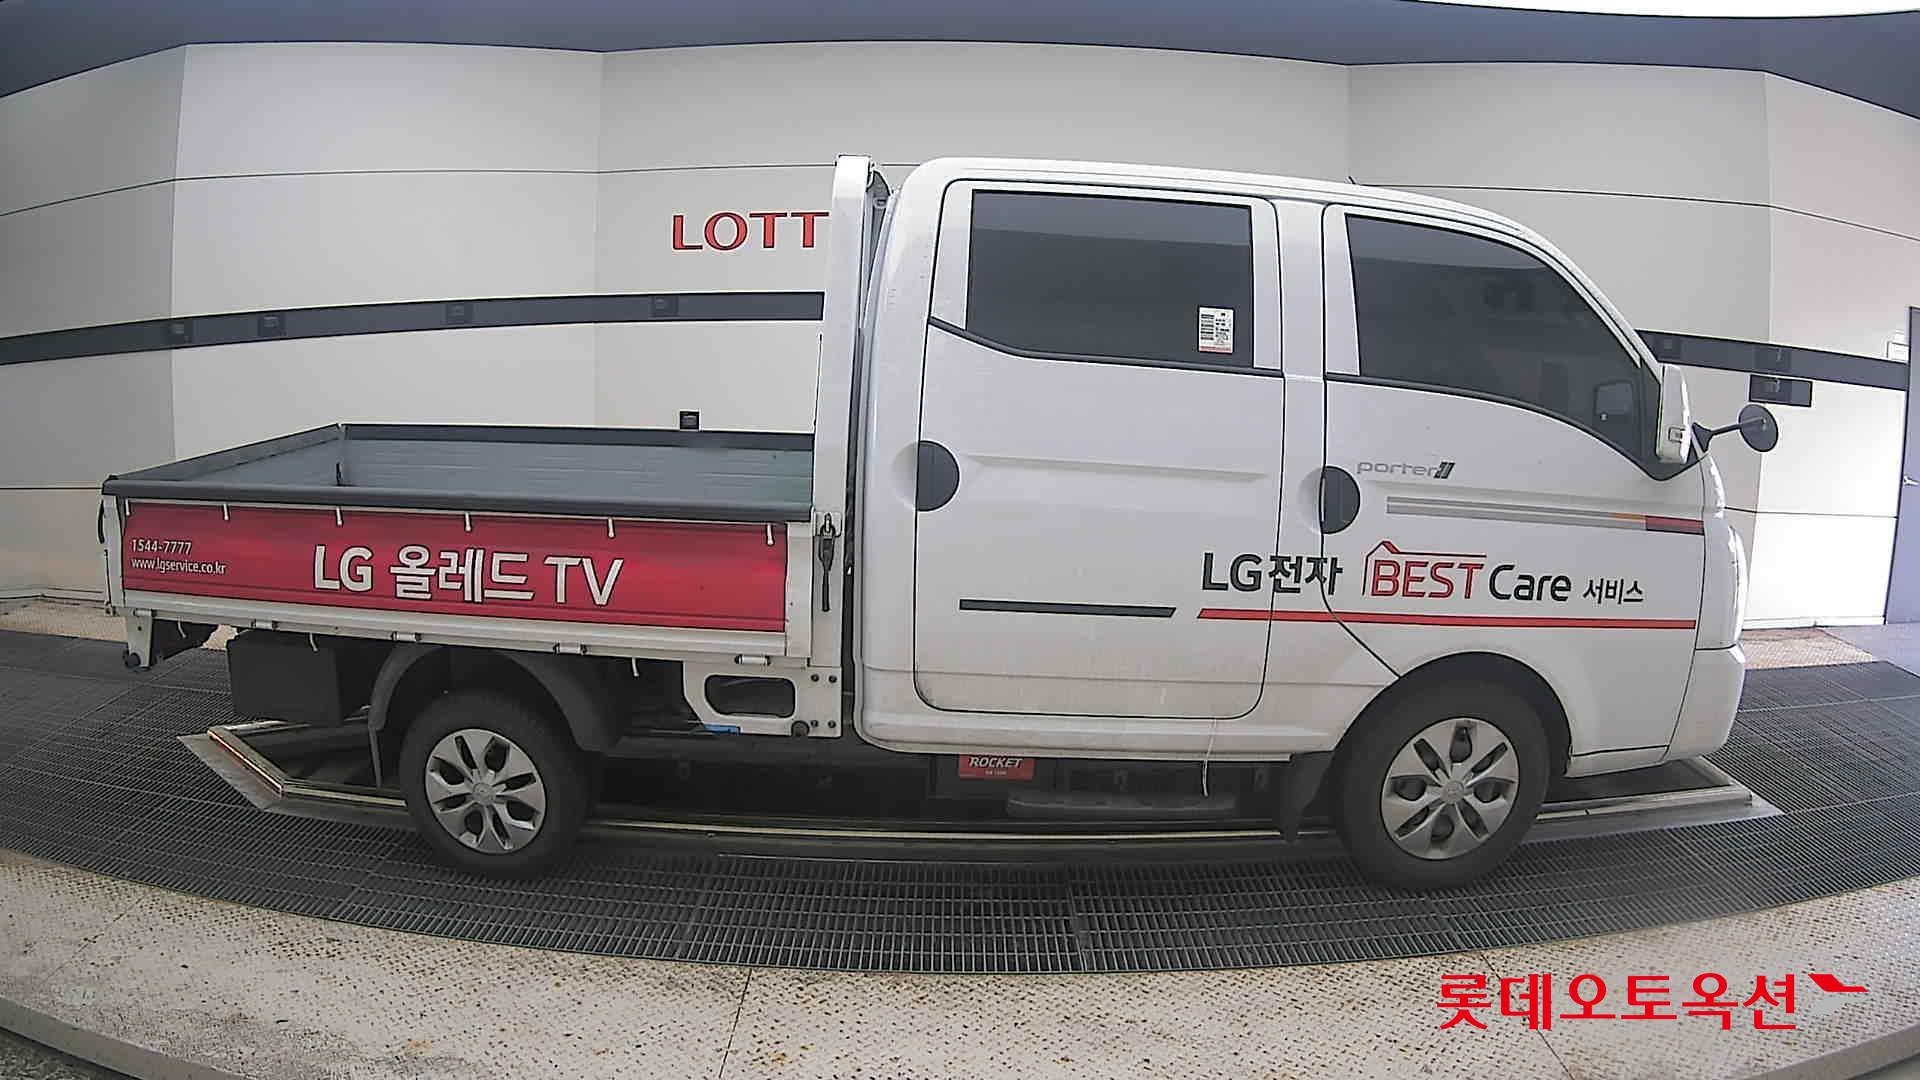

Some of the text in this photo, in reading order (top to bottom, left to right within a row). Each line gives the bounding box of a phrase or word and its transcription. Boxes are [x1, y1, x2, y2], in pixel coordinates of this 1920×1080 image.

[131, 538, 193, 556] 1544-7777
[131, 557, 227, 575] www.lgservice.co.kr
[313, 545, 625, 606] LG 올레드 TV
[1370, 559, 1486, 600] BEST
[1488, 564, 1572, 603] Care
[1583, 577, 1645, 605] 서비스
[968, 757, 1023, 769] ROCKET
